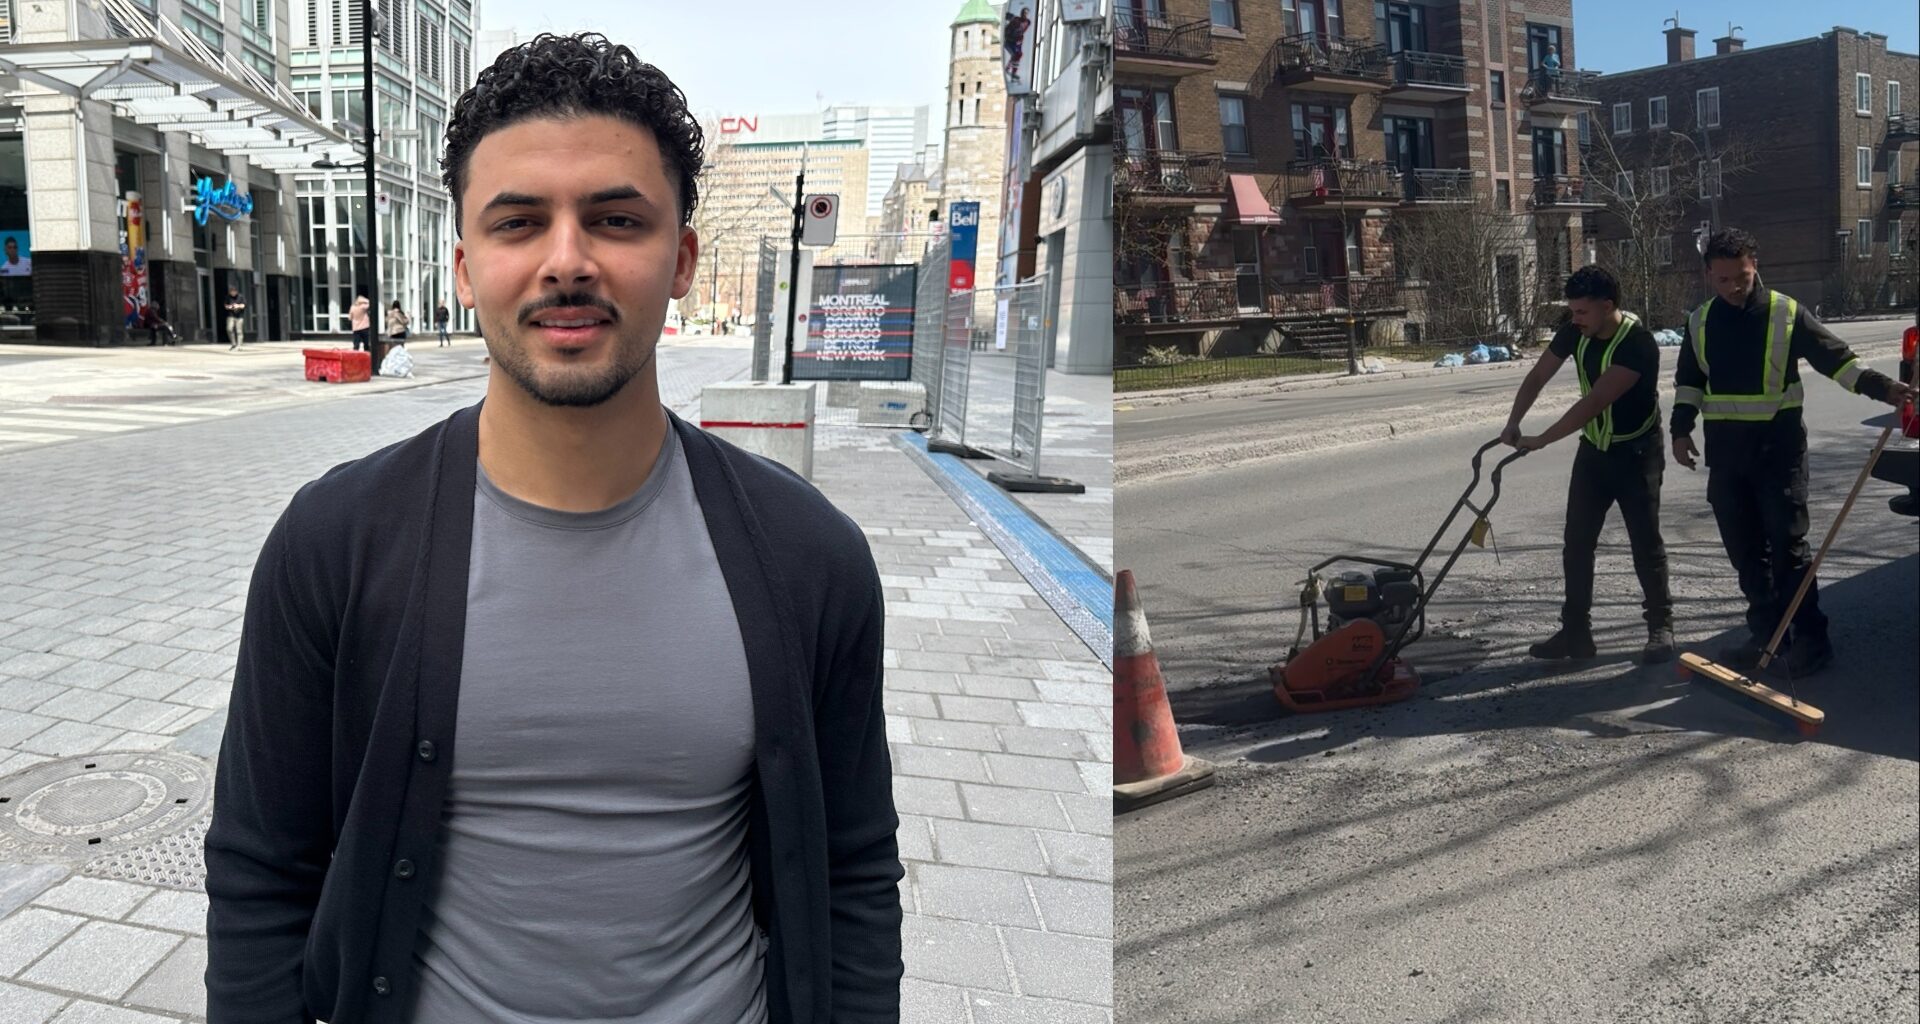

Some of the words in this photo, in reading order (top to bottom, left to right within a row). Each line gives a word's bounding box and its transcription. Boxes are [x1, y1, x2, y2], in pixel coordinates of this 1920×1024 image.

[720, 116, 758, 133] CN
[951, 212, 977, 226] Bell
[818, 294, 890, 306] MONTREAL
[822, 306, 885, 317] TORONTO
[822, 328, 881, 339] CHICAGO
[824, 339, 880, 351] DETROIT
[815, 350, 847, 361] NEW
[851, 350, 886, 361] YORK
